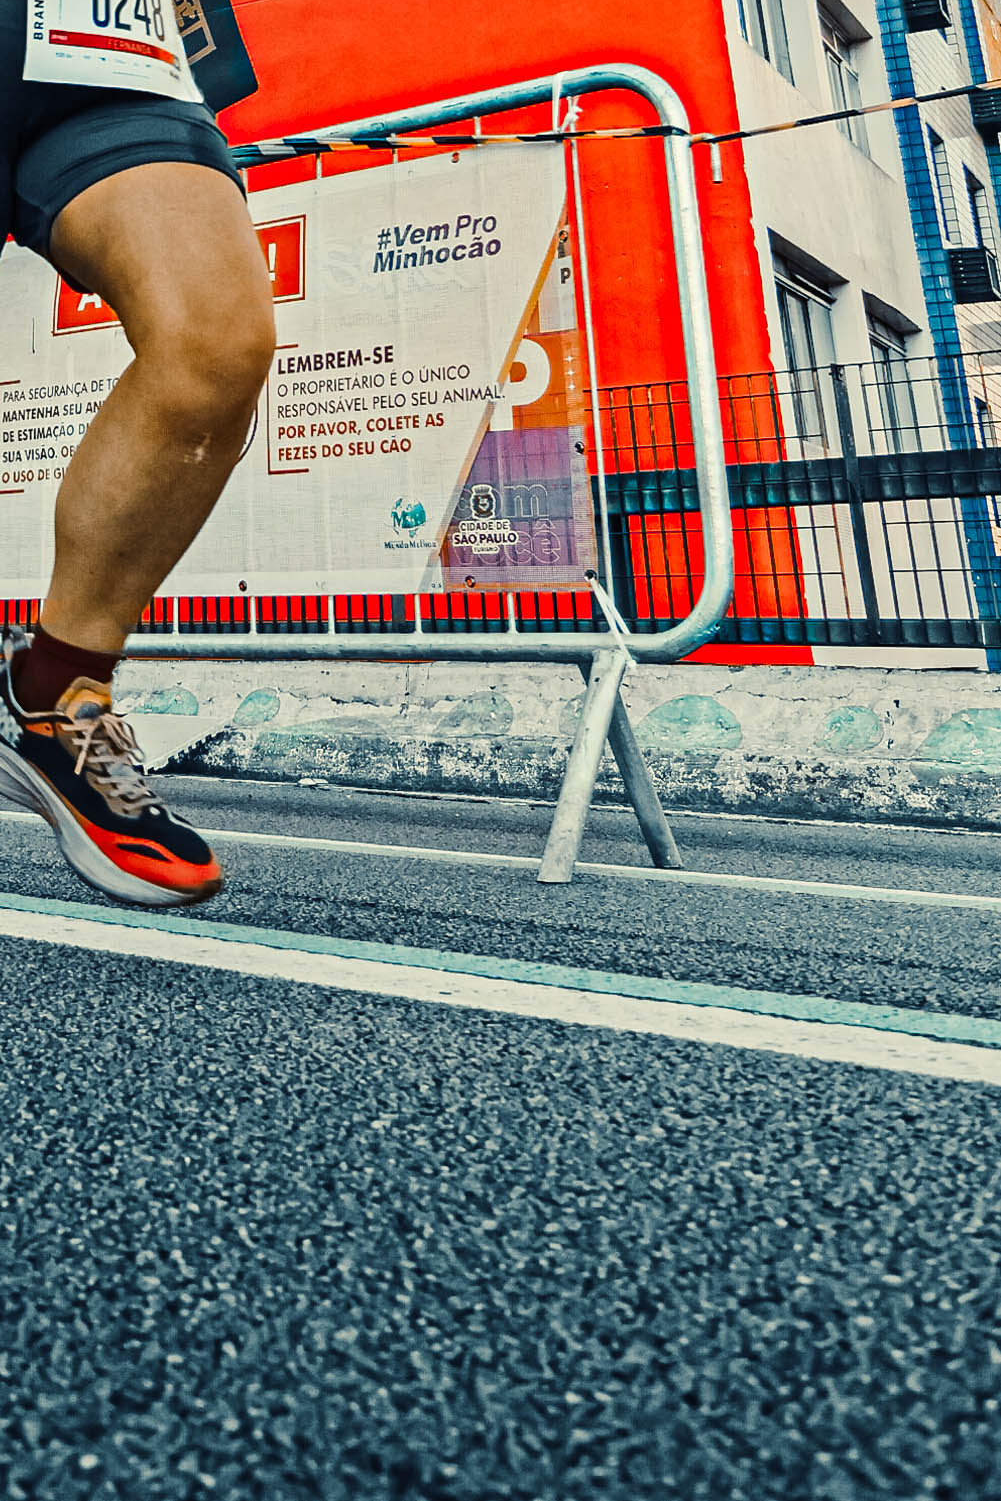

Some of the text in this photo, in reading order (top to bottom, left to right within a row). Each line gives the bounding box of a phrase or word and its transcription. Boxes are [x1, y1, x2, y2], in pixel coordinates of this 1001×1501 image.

[377, 214, 497, 250] #Vem Pro
[373, 236, 501, 273] Minhocão
[277, 345, 394, 375] LEMBREM-SE
[3, 390, 26, 403] PARA
[28, 382, 88, 400] SEGURANÇA
[90, 380, 104, 393] DE
[277, 364, 470, 397] O PROPRIETÁRIO É O ÚNICO
[2, 400, 104, 423] MANTENHA SEU AN
[277, 385, 505, 419] RESPONSÁVEL PELO SEU ANIMAL.
[2, 430, 16, 443] DE
[17, 422, 75, 441] ESTIMAÇÃO
[278, 412, 444, 440] POR FAVOR, COLETE AS
[2, 450, 22, 463] SUA
[24, 443, 58, 461] VISÃO.
[278, 435, 412, 461] FEZES DO SEU CÃO
[2, 471, 10, 484] O
[13, 470, 35, 483] USO
[37, 468, 51, 481] DE
[454, 530, 517, 545] SÃO PAULO
[460, 521, 508, 531] CIDADE DE
